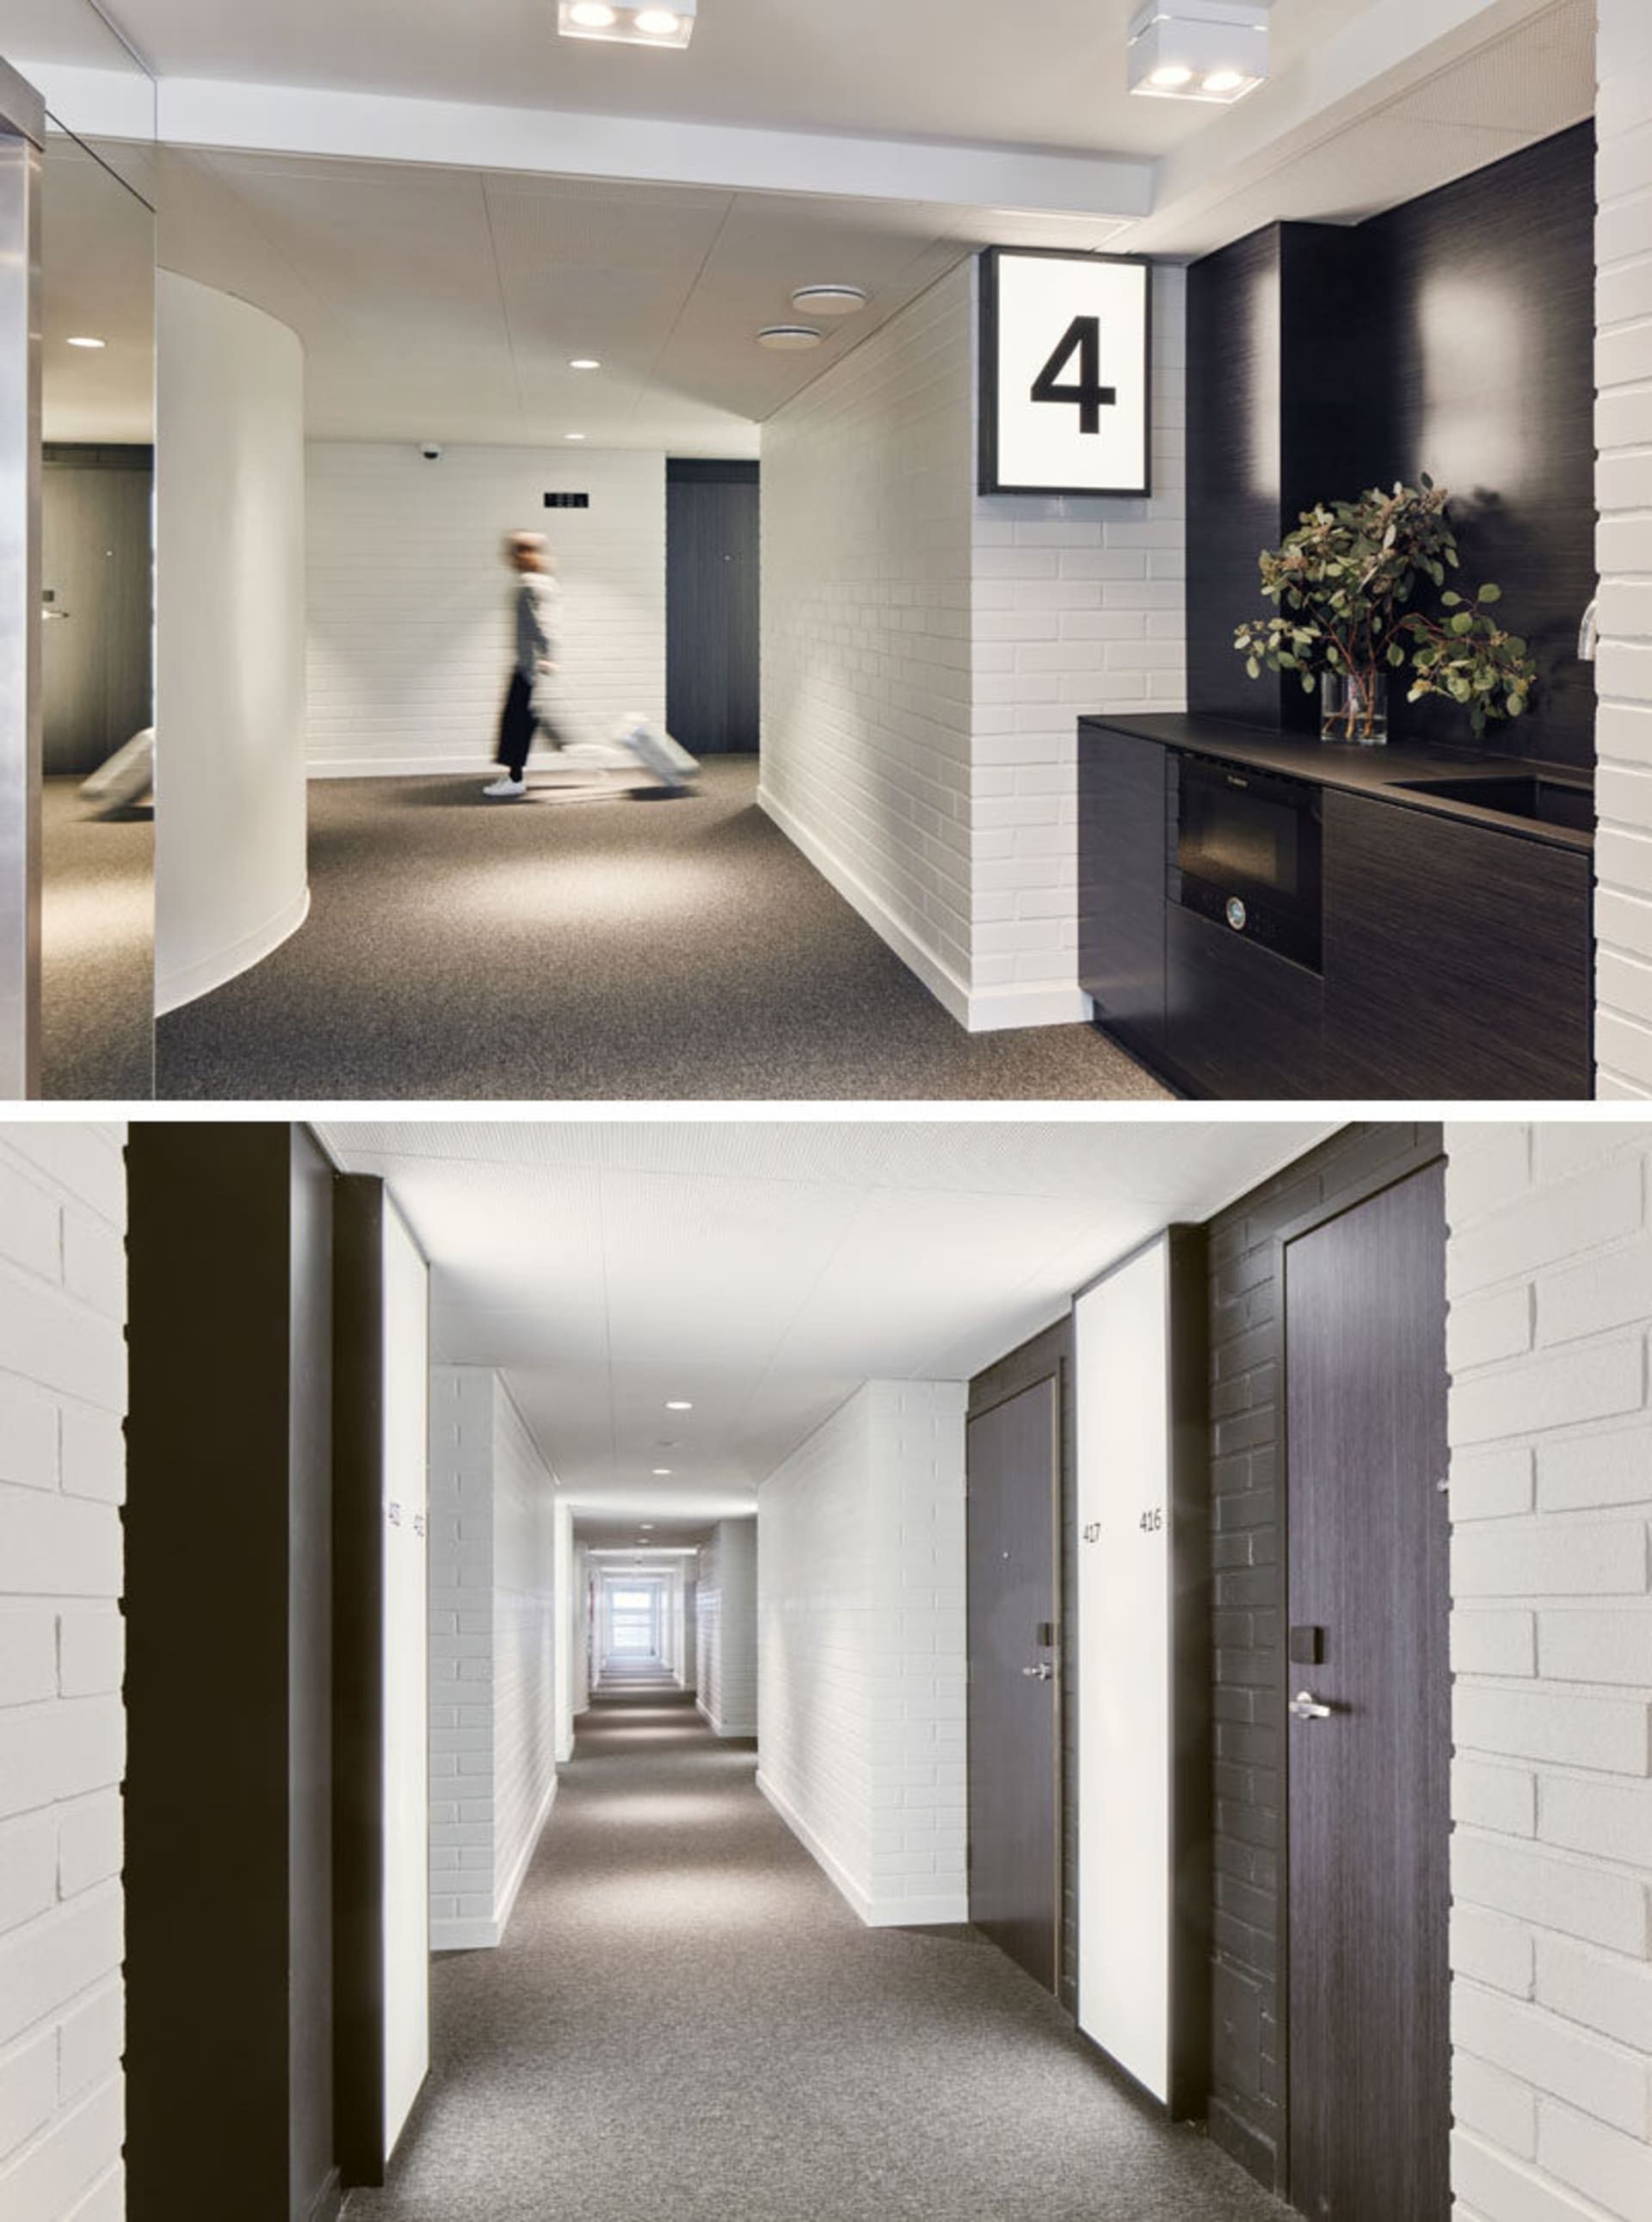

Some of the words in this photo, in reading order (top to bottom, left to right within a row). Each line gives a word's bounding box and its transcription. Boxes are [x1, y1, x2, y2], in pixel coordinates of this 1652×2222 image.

[1031, 316, 1116, 434] 4
[1082, 1521, 1101, 1543] 417
[1139, 1508, 1162, 1533] 416
